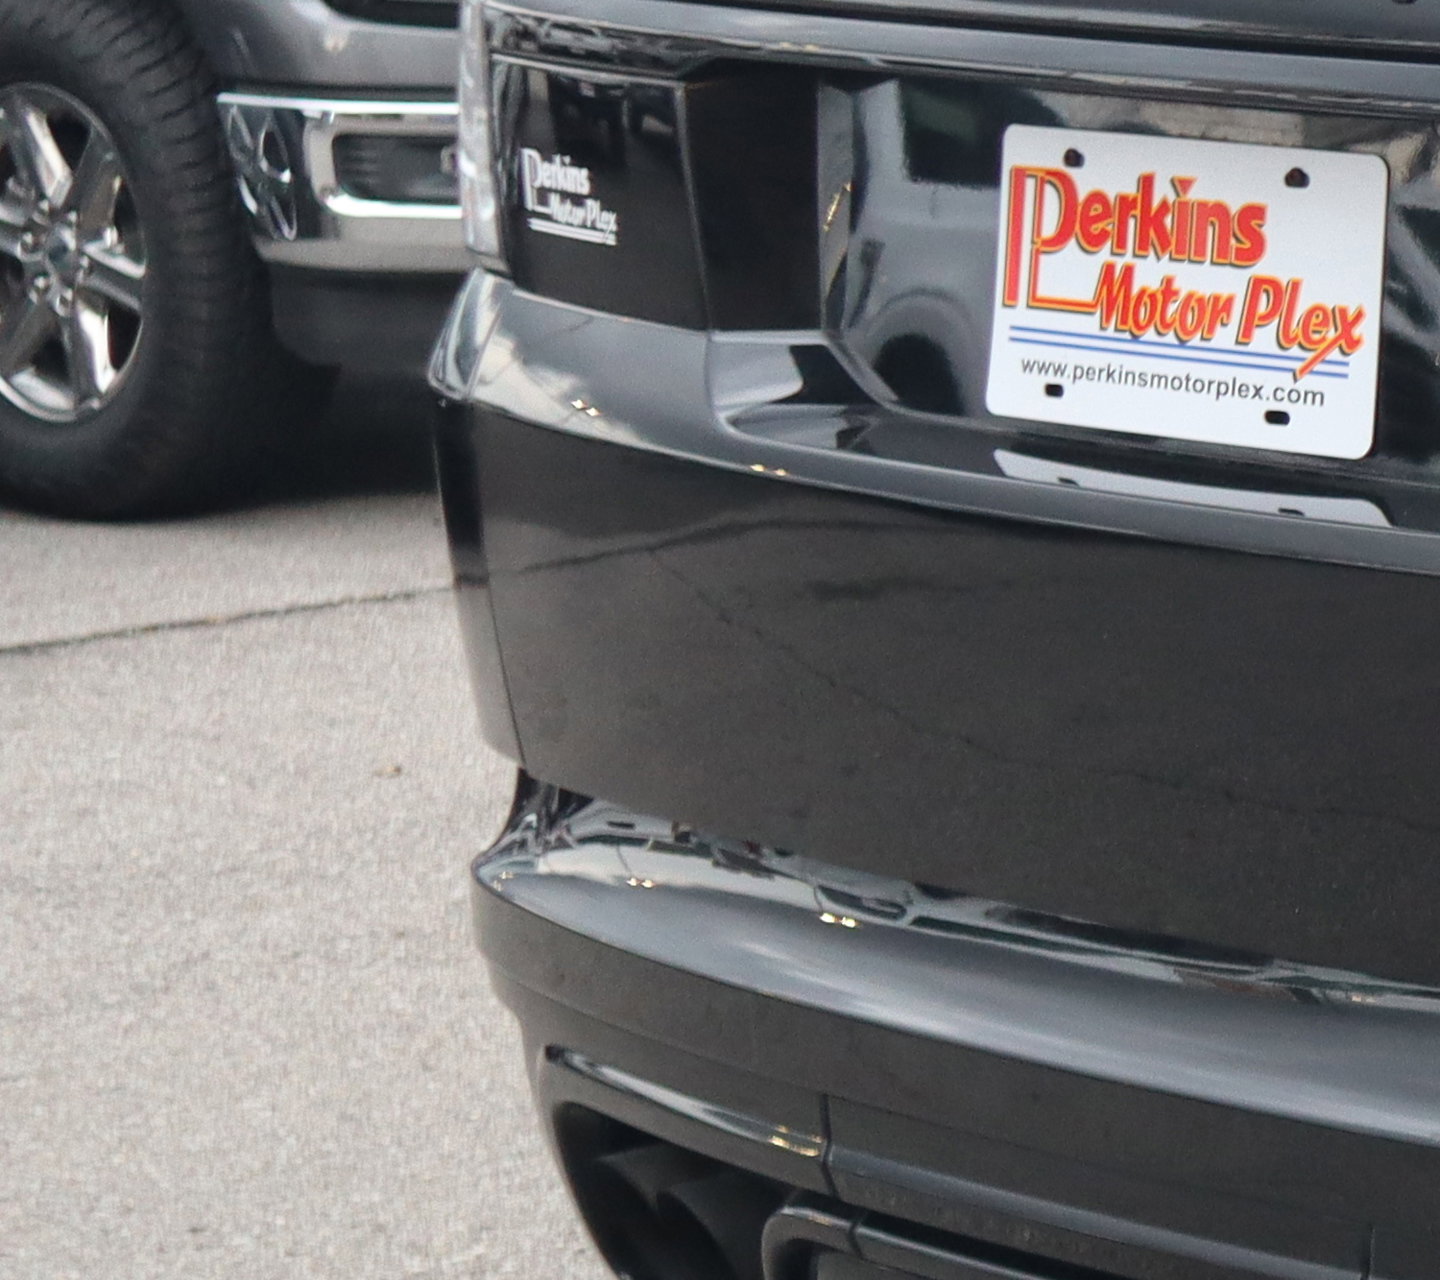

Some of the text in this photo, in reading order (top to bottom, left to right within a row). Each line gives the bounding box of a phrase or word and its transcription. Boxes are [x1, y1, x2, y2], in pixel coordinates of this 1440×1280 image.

[521, 147, 591, 211] Perkins
[1002, 165, 1268, 311] Perkins
[1098, 261, 1366, 381] Motor Plex
[1020, 358, 1326, 408] www.perkinsmotorplex.com
